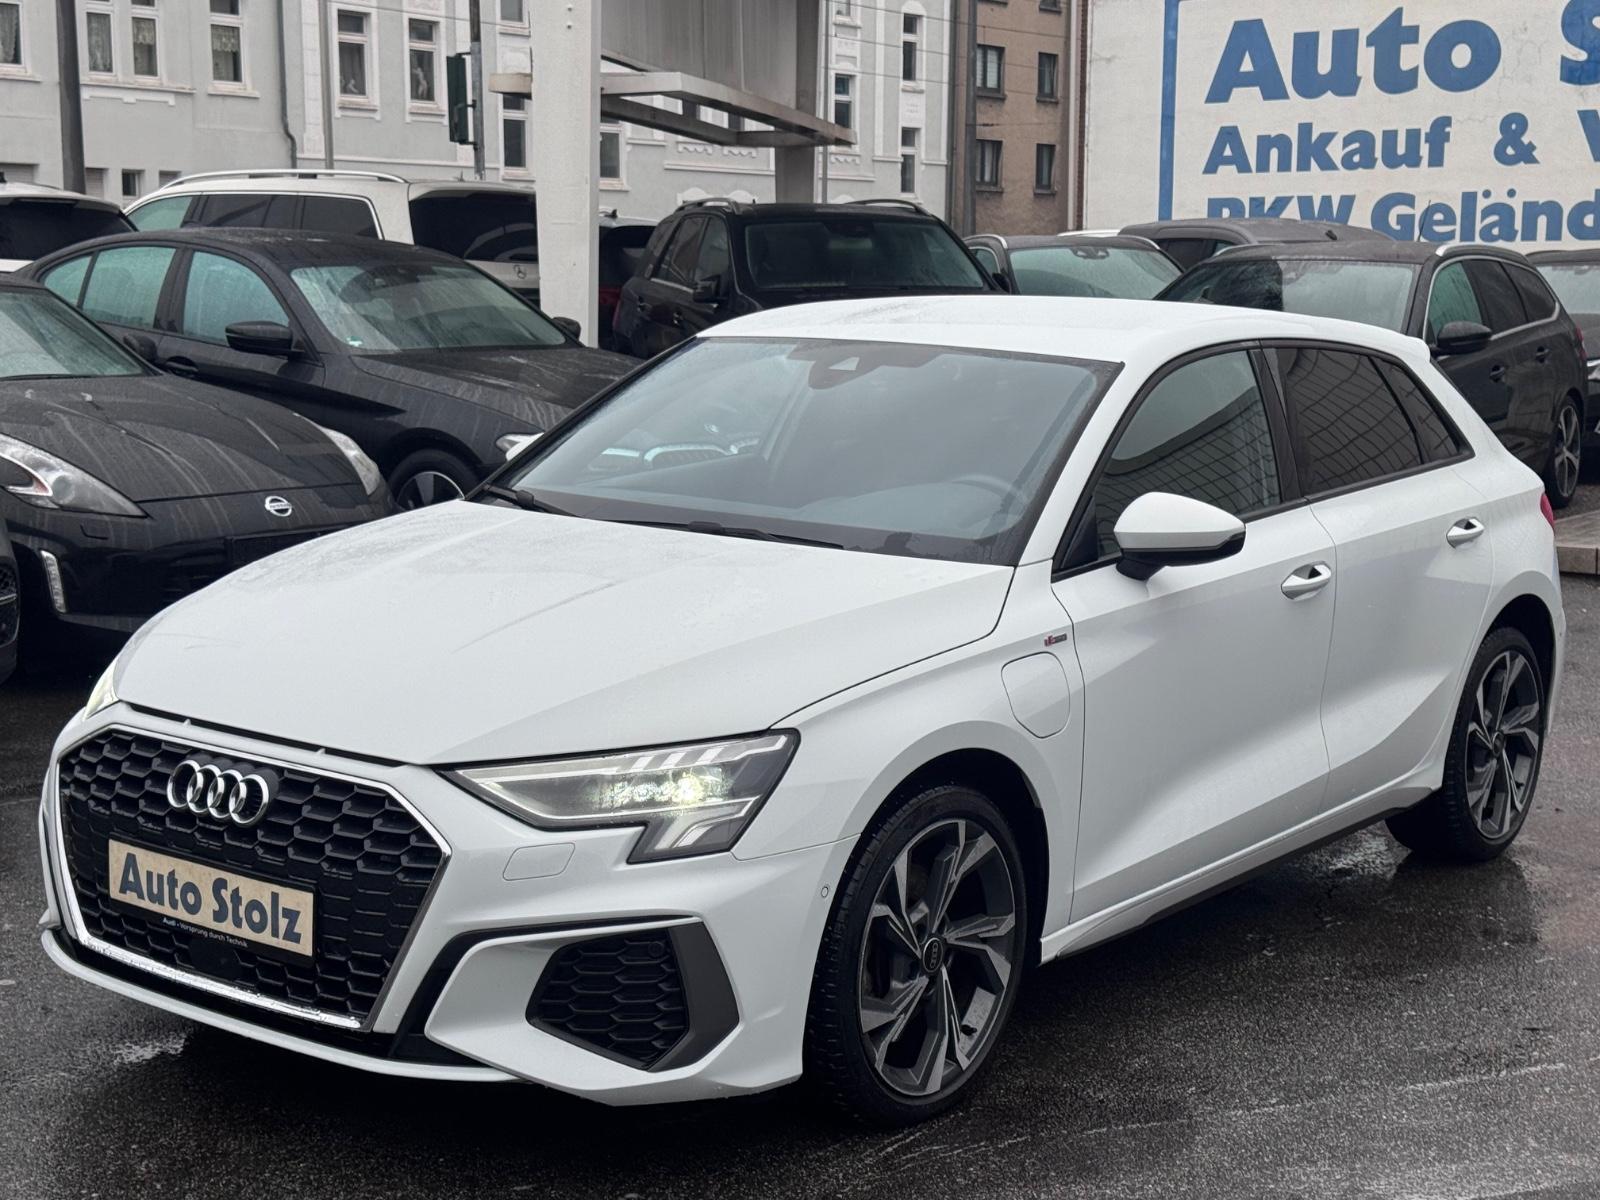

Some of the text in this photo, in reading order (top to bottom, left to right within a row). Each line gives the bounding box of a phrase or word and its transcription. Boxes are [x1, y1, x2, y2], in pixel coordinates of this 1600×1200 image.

[1204, 6, 1502, 104] Auto
[1202, 115, 1452, 175] Ankauf
[1493, 112, 1541, 166] &
[119, 852, 301, 944] Auto Stolz
[180, 922, 208, 937] Vorsprung
[208, 932, 225, 941] durch
[226, 935, 248, 948] Technik
